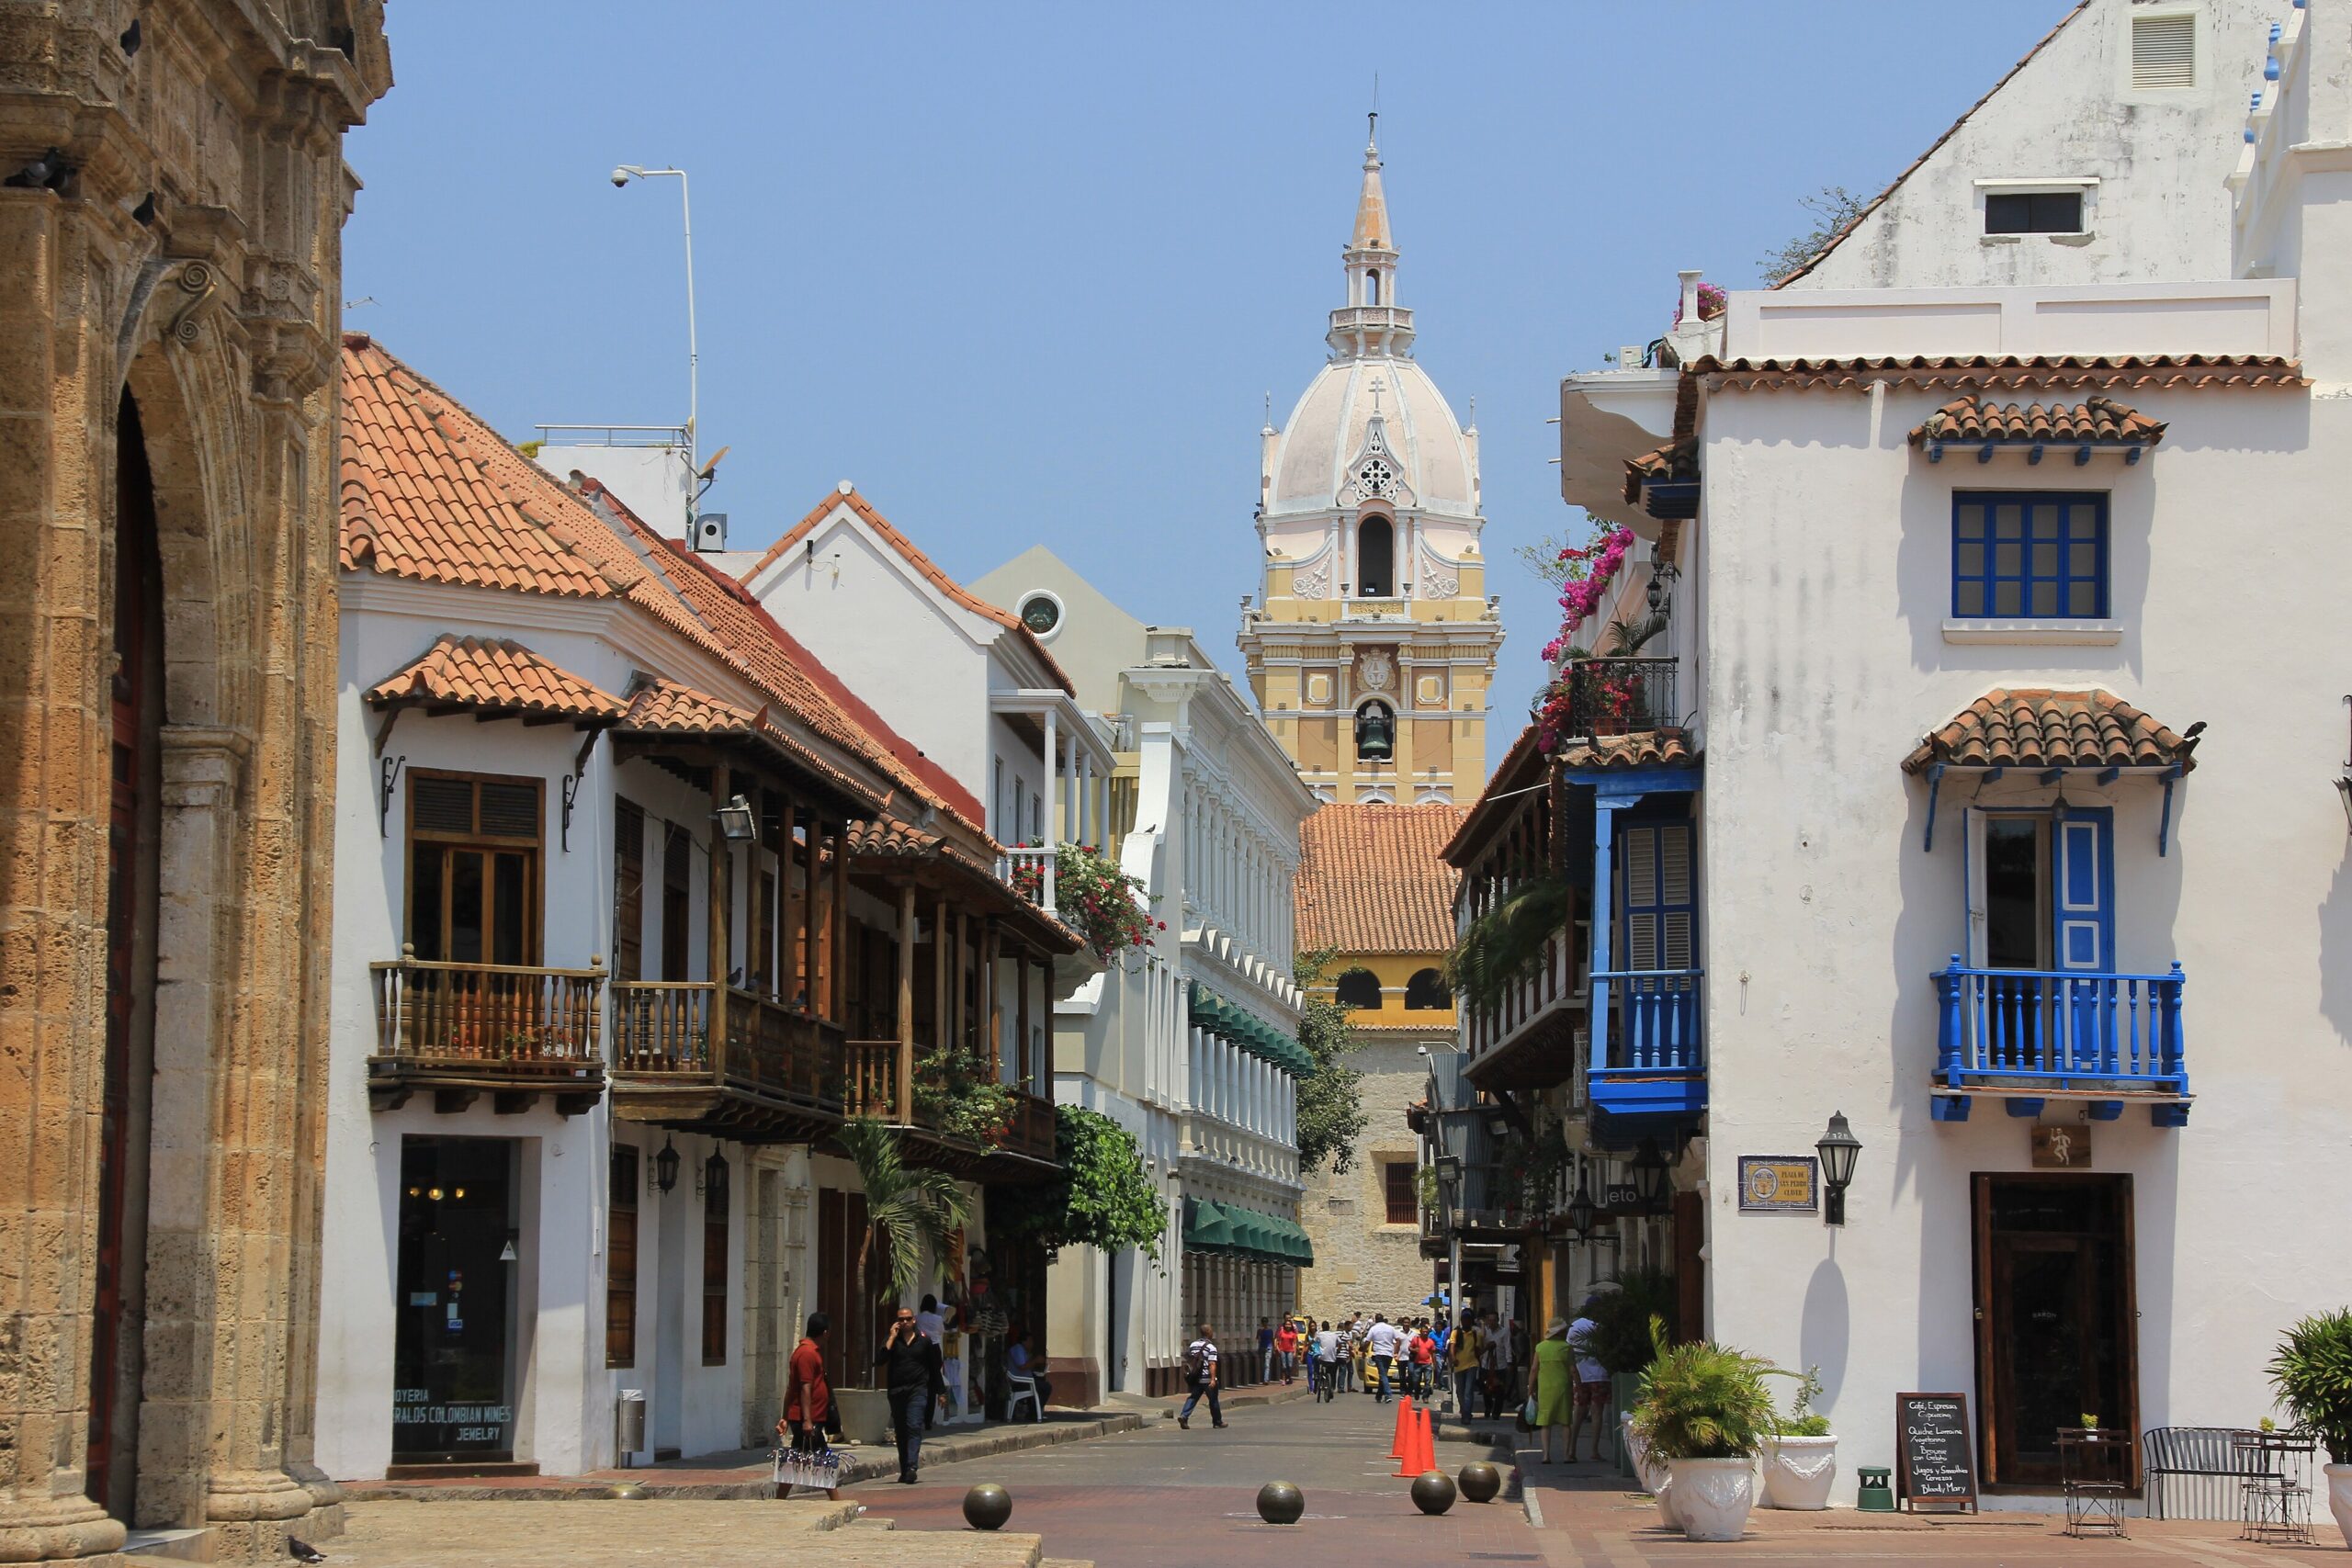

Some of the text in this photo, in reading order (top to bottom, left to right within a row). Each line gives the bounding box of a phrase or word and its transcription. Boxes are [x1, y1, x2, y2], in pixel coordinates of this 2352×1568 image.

[428, 1406, 481, 1423] COLOMBIAN
[483, 1406, 512, 1423] MINES
[457, 1427, 500, 1441] JEWELRY
[1908, 1426, 1934, 1435] Quiche
[1919, 1445, 1948, 1454] Brownie
[1926, 1453, 1948, 1461] Gelato
[1913, 1464, 1934, 1475] Jugos
[1940, 1464, 1969, 1474] Smoothies
[1925, 1473, 1953, 1482] Cervezas
[1920, 1482, 1966, 1495] Bloody Mary
